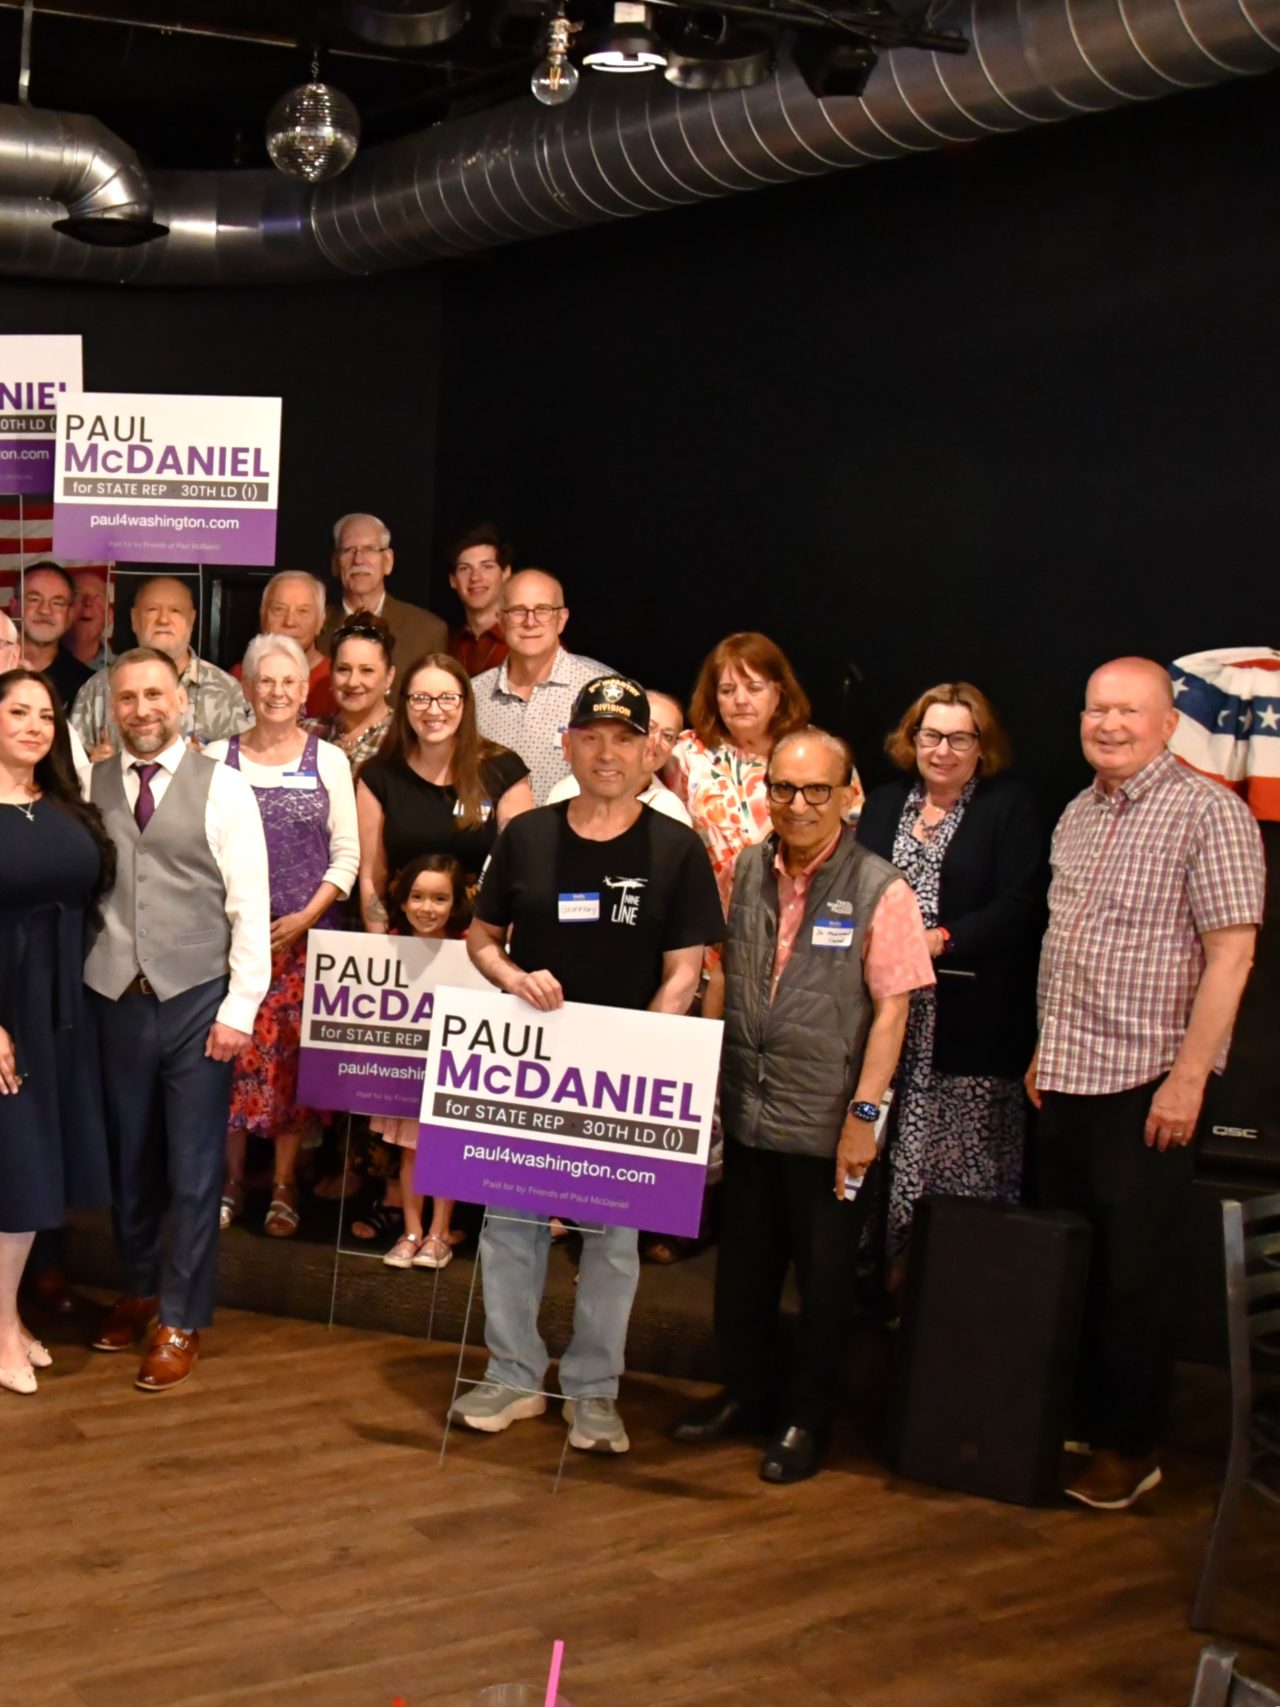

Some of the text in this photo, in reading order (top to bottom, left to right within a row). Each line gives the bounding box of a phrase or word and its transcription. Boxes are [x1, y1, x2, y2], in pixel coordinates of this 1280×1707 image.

[30, 418, 45, 430] LD
[66, 414, 152, 442] PAUL
[64, 442, 270, 477] McDANIEL
[73, 482, 92, 494] for
[97, 482, 137, 495] STATE
[142, 484, 167, 496] REP
[181, 485, 216, 497] 30TH
[221, 486, 237, 498] LD
[90, 514, 239, 531] paul4washington.com
[593, 703, 631, 717] DIVISION
[624, 895, 640, 906] NINE
[314, 953, 409, 989] PAUL
[312, 983, 435, 1024] McDA
[320, 1025, 423, 1047] for STATE REP
[441, 1014, 552, 1062] PAUL
[338, 1062, 426, 1081] paul4washi
[436, 1049, 702, 1123] McDANIEL
[445, 1099, 470, 1117] for
[475, 1104, 527, 1127] STATE
[532, 1112, 564, 1131] REP
[582, 1119, 628, 1141] 30TH
[634, 1126, 656, 1144] LD
[1212, 1125, 1258, 1139] QSC
[463, 1143, 656, 1185] paul4washington.com
